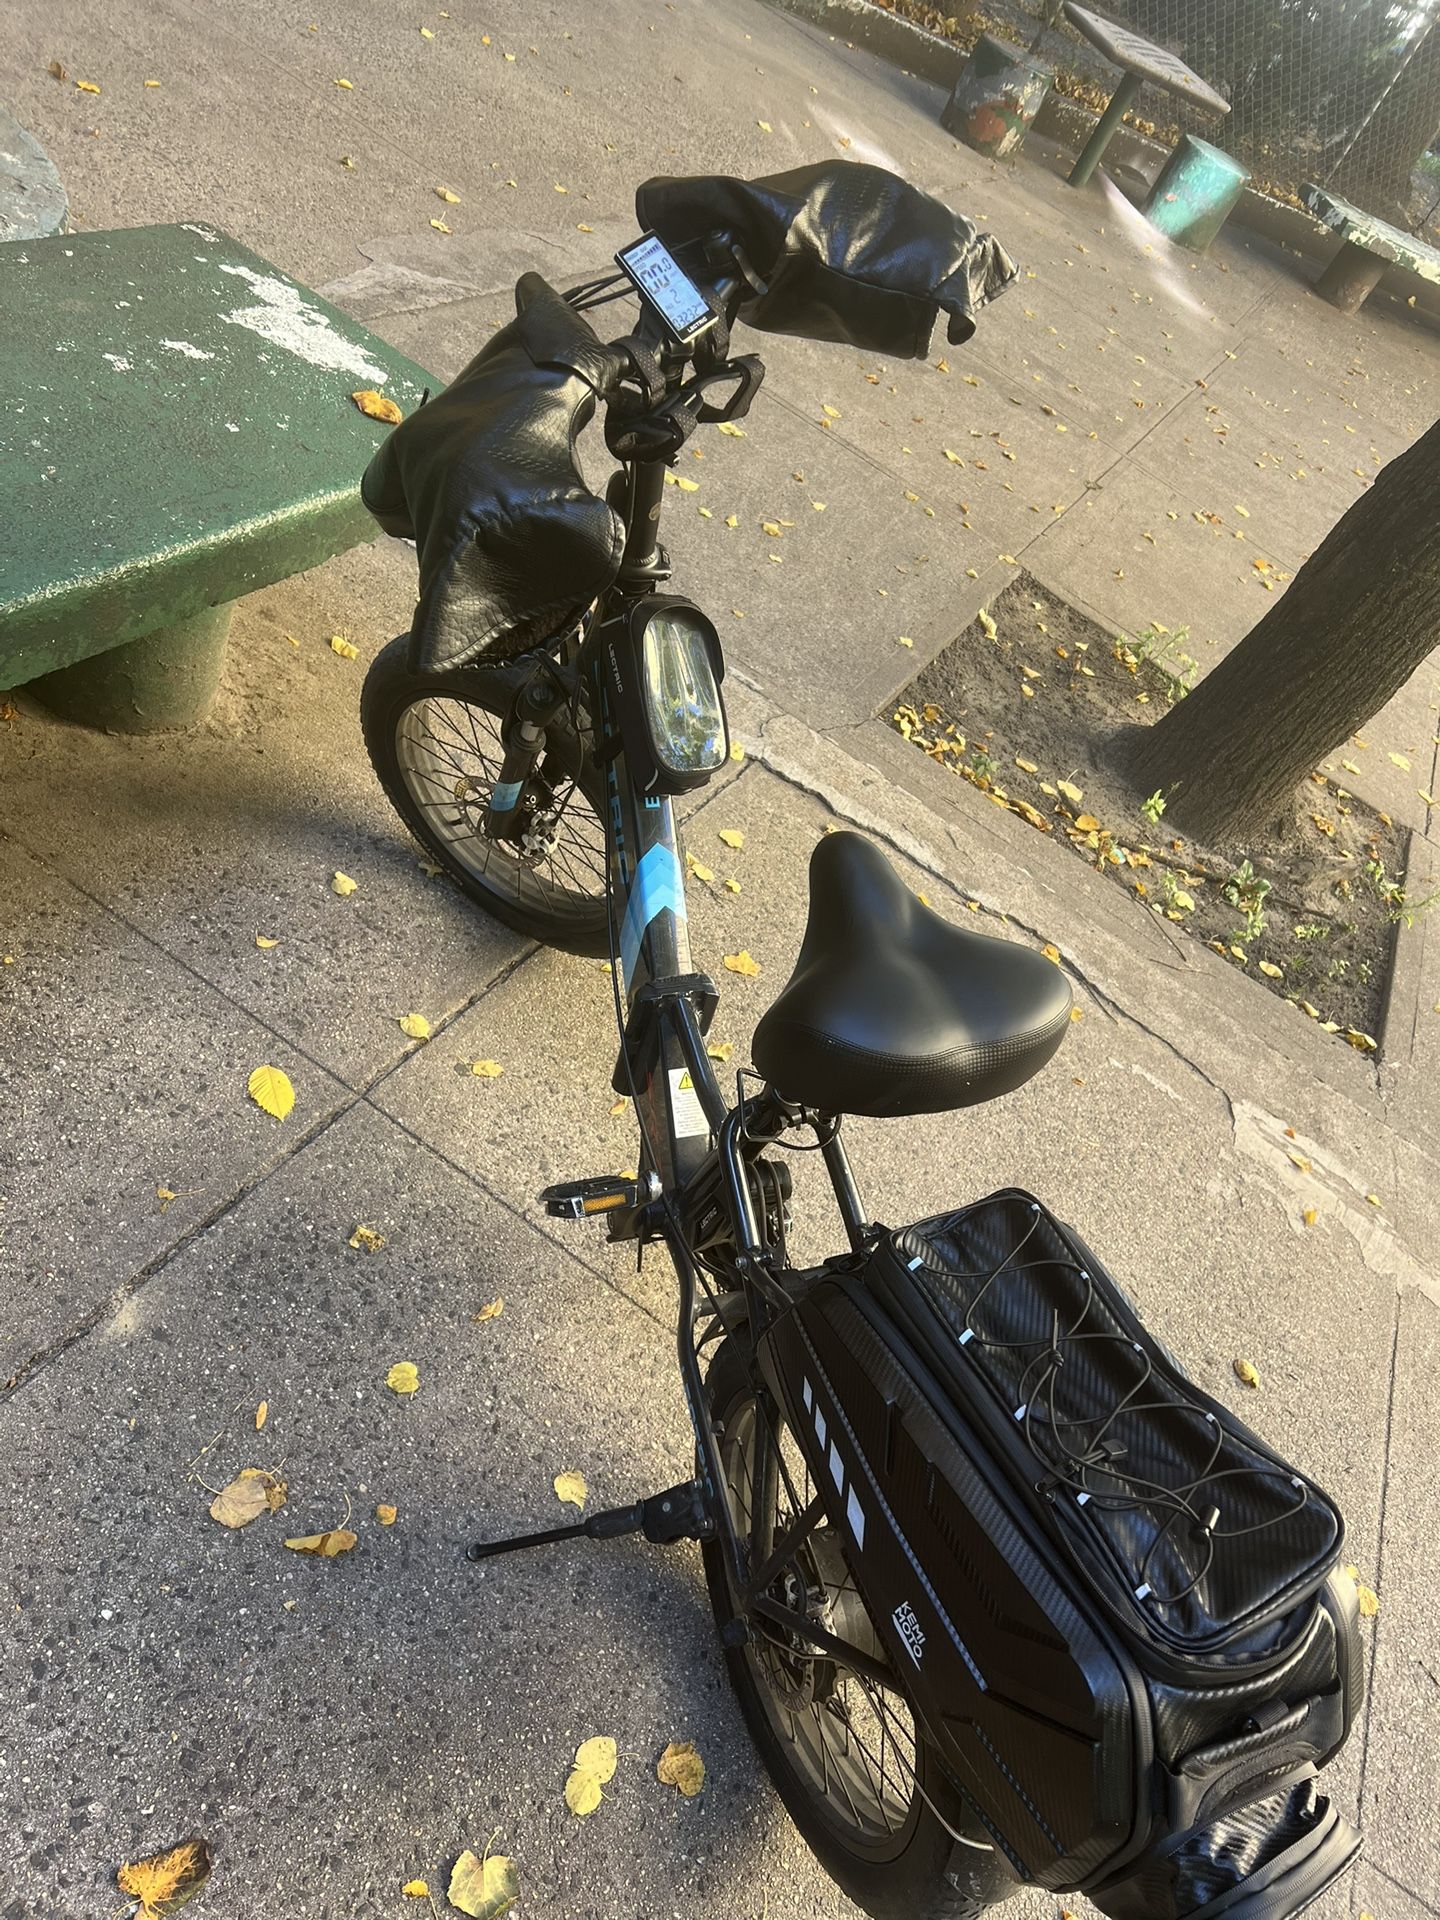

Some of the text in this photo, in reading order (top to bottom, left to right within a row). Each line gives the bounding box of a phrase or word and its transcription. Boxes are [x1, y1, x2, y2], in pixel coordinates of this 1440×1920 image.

[608, 642, 624, 693] LECTRIC
[894, 1606, 922, 1658] MOTO
[901, 1601, 926, 1645] KEMI
